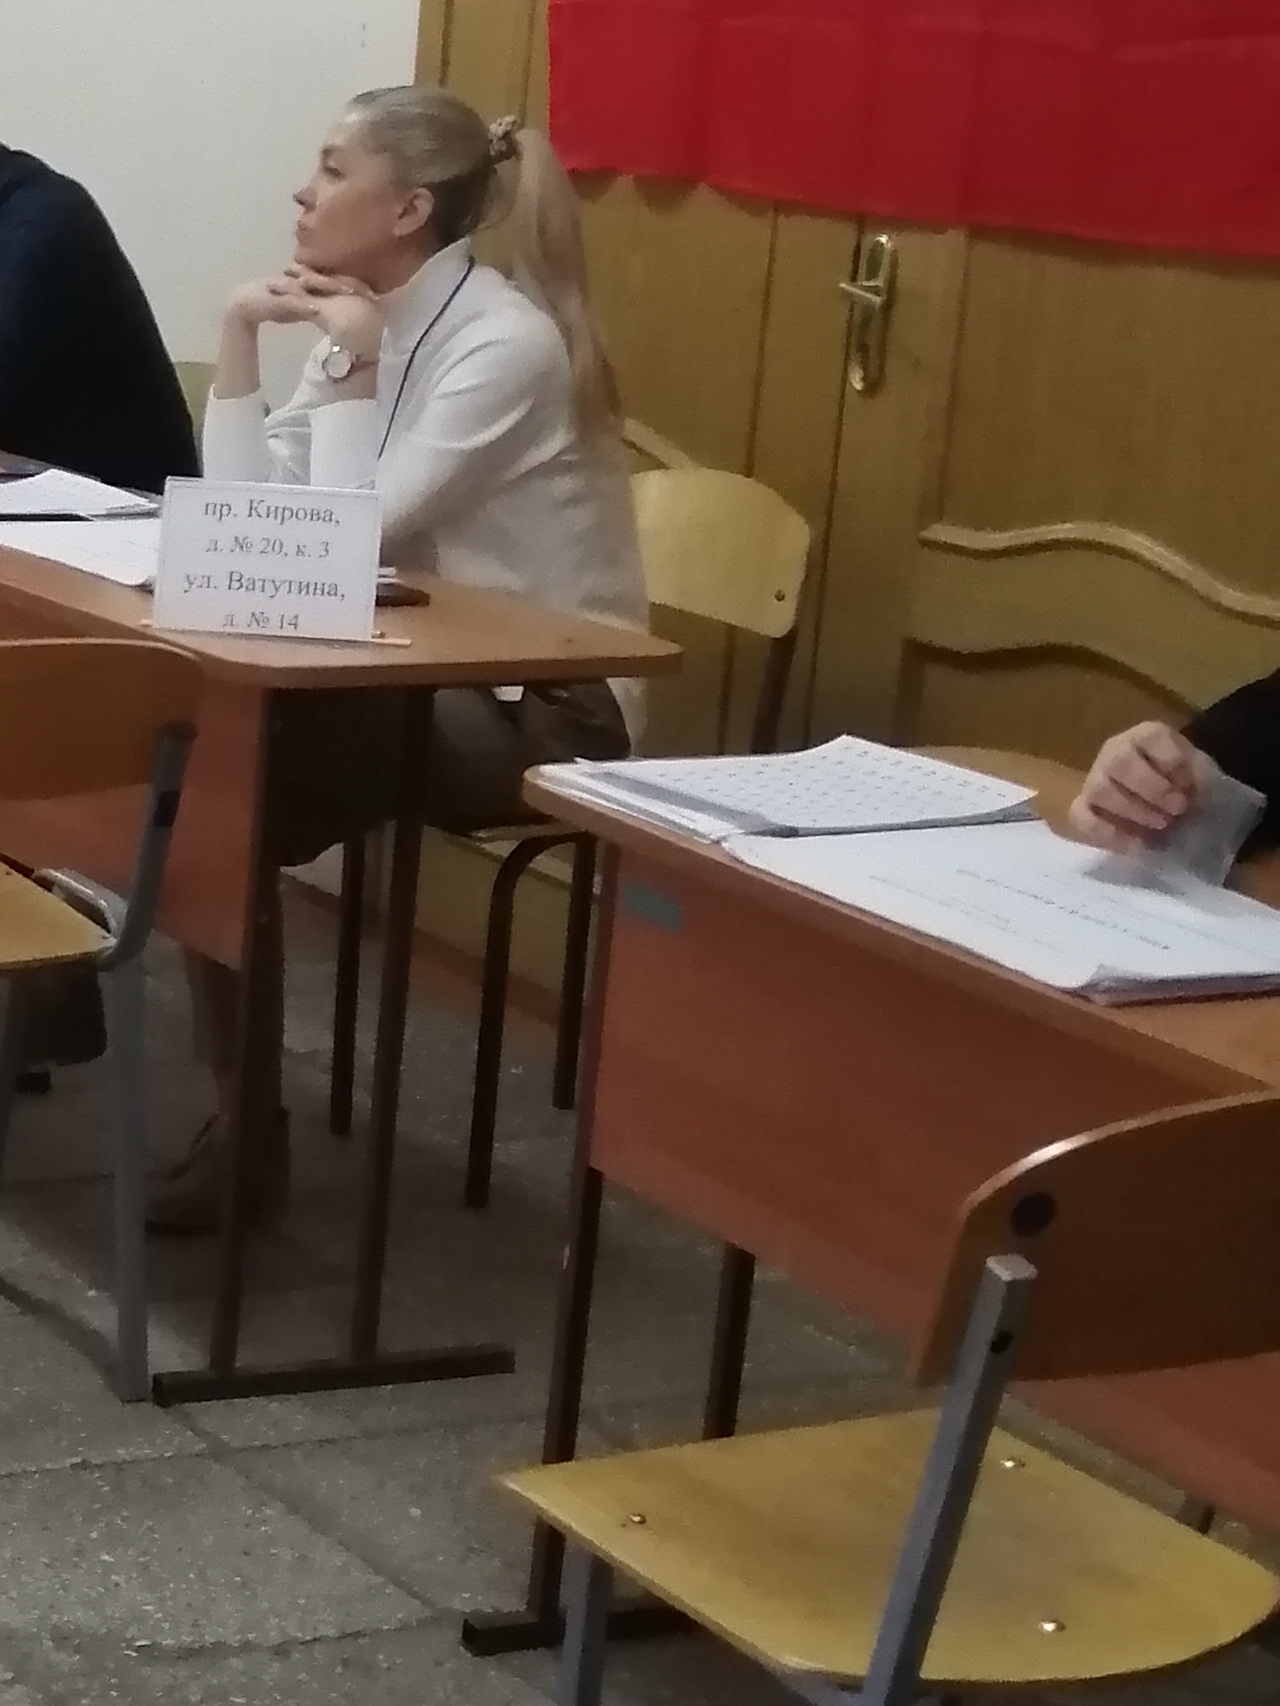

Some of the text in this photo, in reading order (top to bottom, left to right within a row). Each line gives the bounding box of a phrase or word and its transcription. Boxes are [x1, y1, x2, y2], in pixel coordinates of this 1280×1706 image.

[203, 498, 342, 528] пр. Кирова,
[204, 537, 224, 554] д.
[229, 535, 254, 554] №
[295, 543, 312, 558] к.
[318, 540, 330, 558] 3
[183, 570, 346, 602] ул. Ватутина,
[246, 610, 270, 630] №
[279, 612, 300, 631] 14
